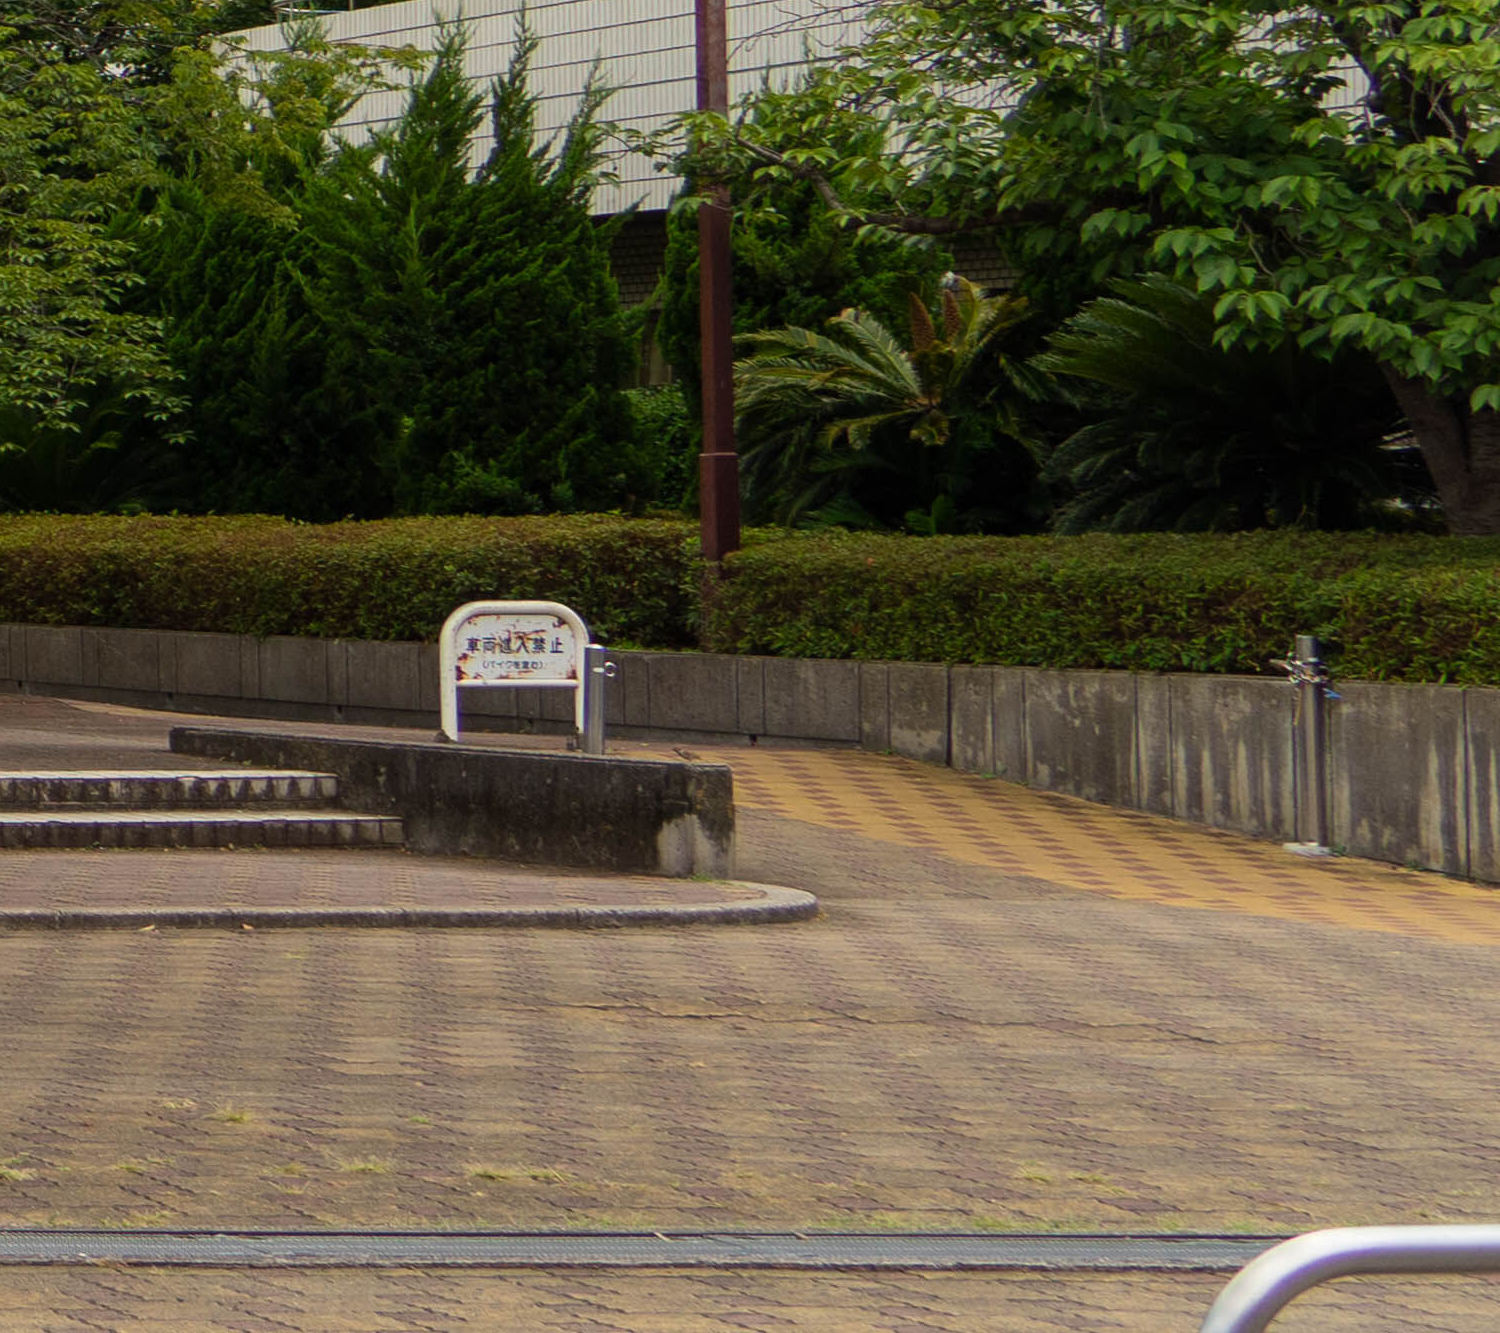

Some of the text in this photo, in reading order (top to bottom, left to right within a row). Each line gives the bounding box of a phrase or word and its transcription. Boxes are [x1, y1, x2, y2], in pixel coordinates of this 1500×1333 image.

[466, 636, 564, 654] 車両進入禁止
